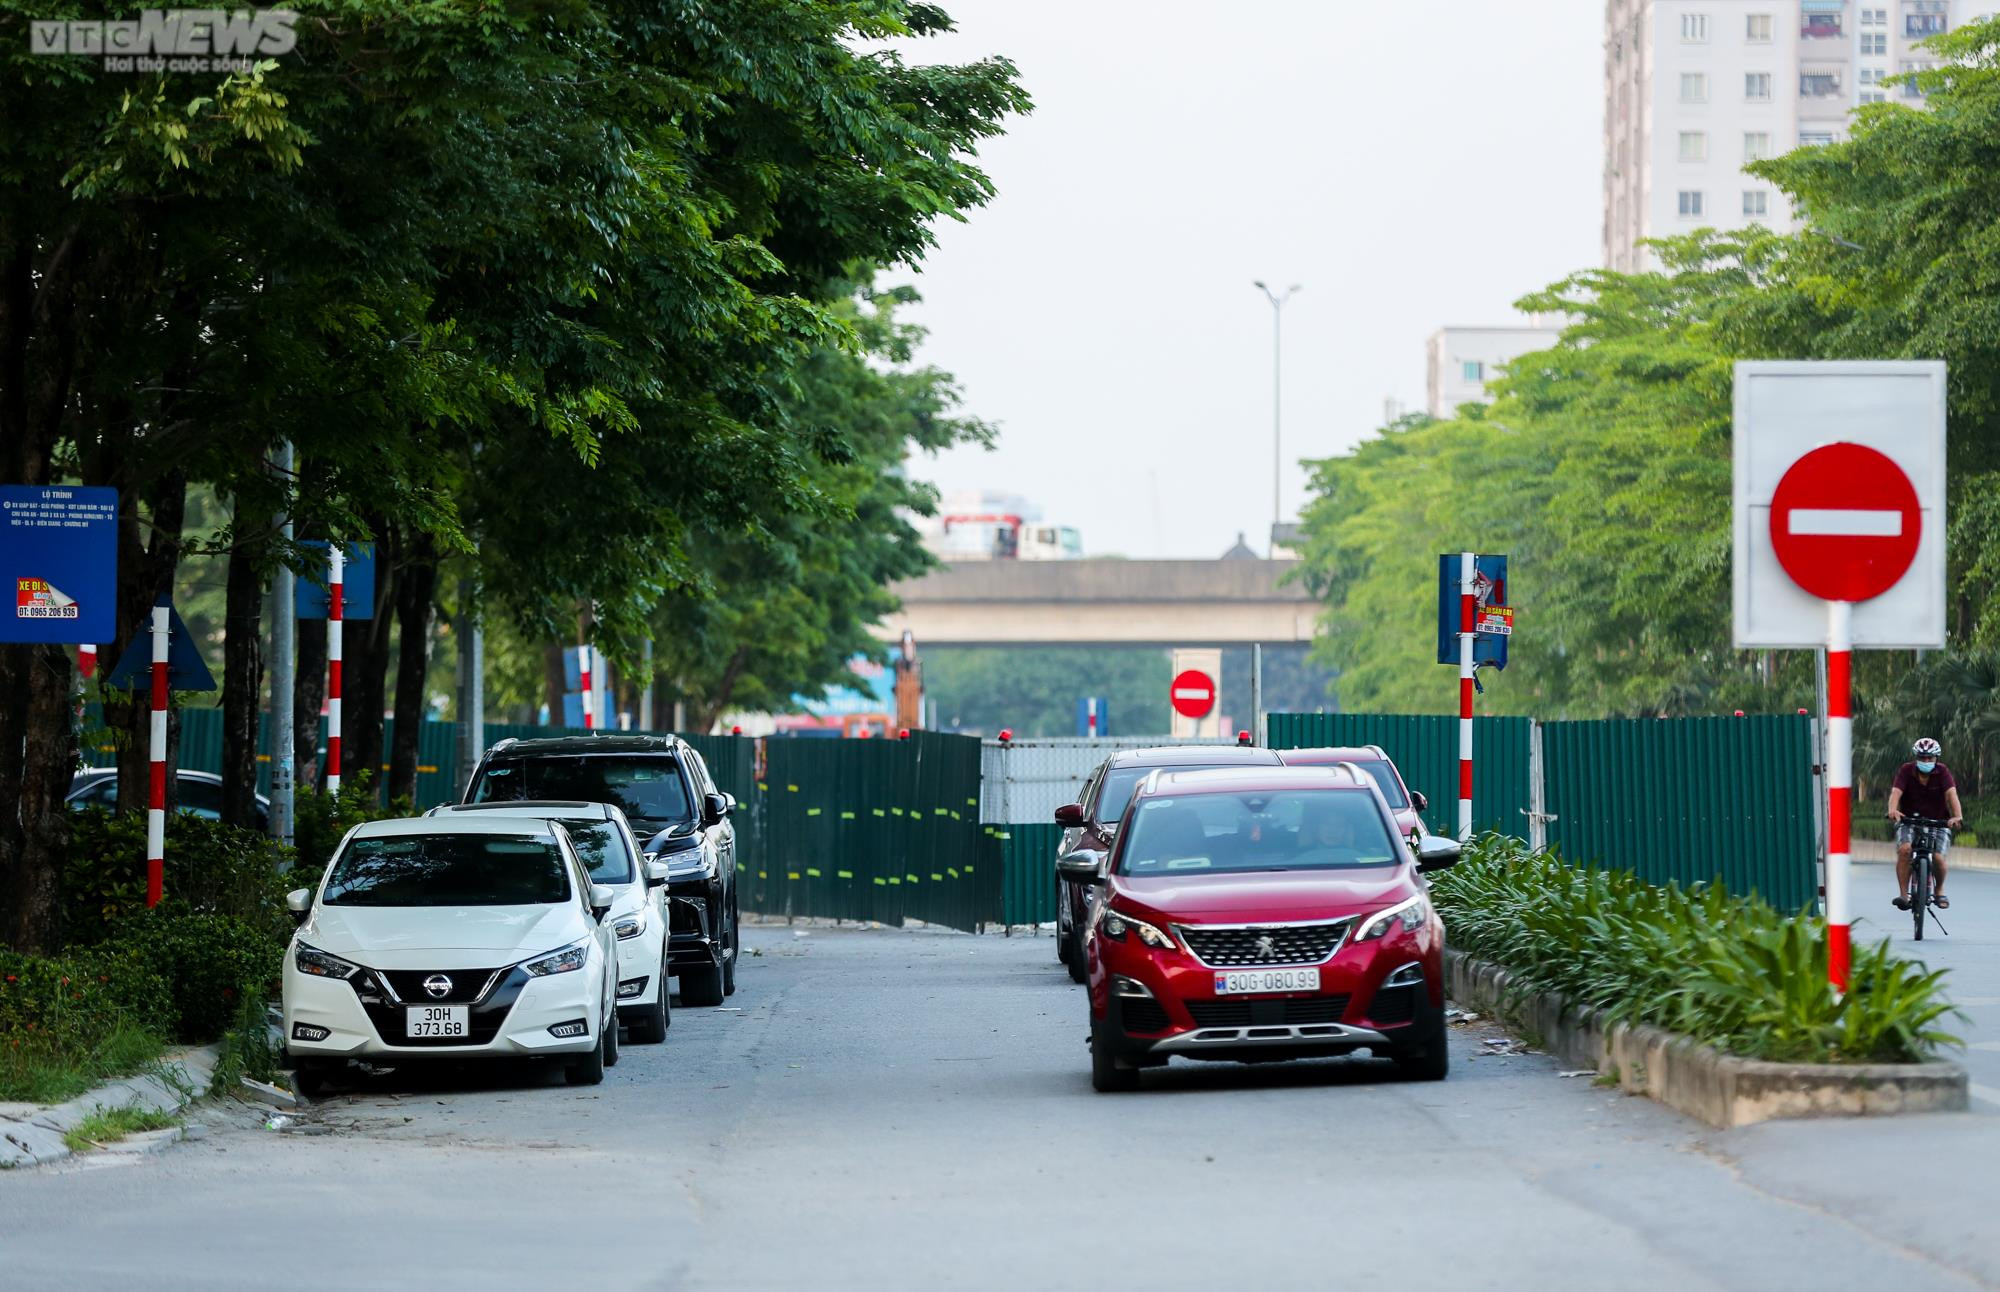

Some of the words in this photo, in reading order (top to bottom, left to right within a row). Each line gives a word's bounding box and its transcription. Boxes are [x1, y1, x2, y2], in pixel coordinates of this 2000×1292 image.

[52, 489, 72, 499] TRÌNH
[20, 581, 30, 590] XE
[30, 608, 47, 616] 0965
[48, 608, 62, 616] 206
[62, 608, 76, 616] 936
[1228, 971, 1317, 991] 30G-080.99
[424, 1008, 450, 1020] 30H
[414, 1022, 462, 1036] 373.68
